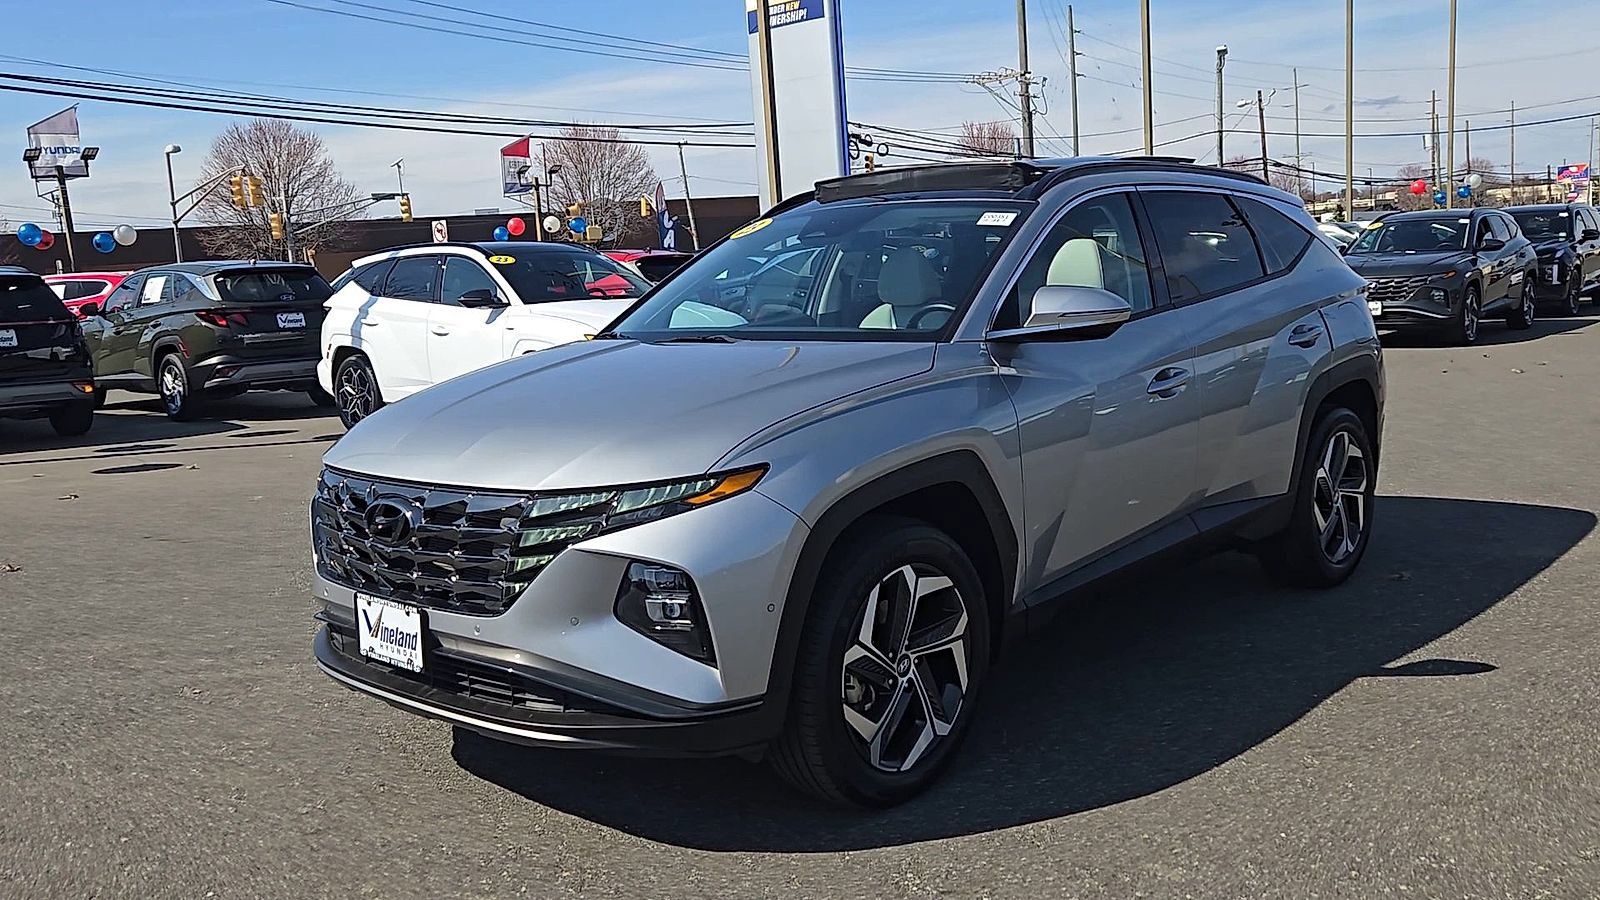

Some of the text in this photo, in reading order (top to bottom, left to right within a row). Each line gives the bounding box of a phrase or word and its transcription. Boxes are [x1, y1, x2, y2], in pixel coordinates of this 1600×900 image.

[769, 1, 800, 15] NDER NEW
[769, 8, 808, 26] NERSHIP!
[37, 146, 80, 154] YUNDAI
[362, 605, 418, 651] Vineland
[380, 643, 418, 660] HYUNDAI
